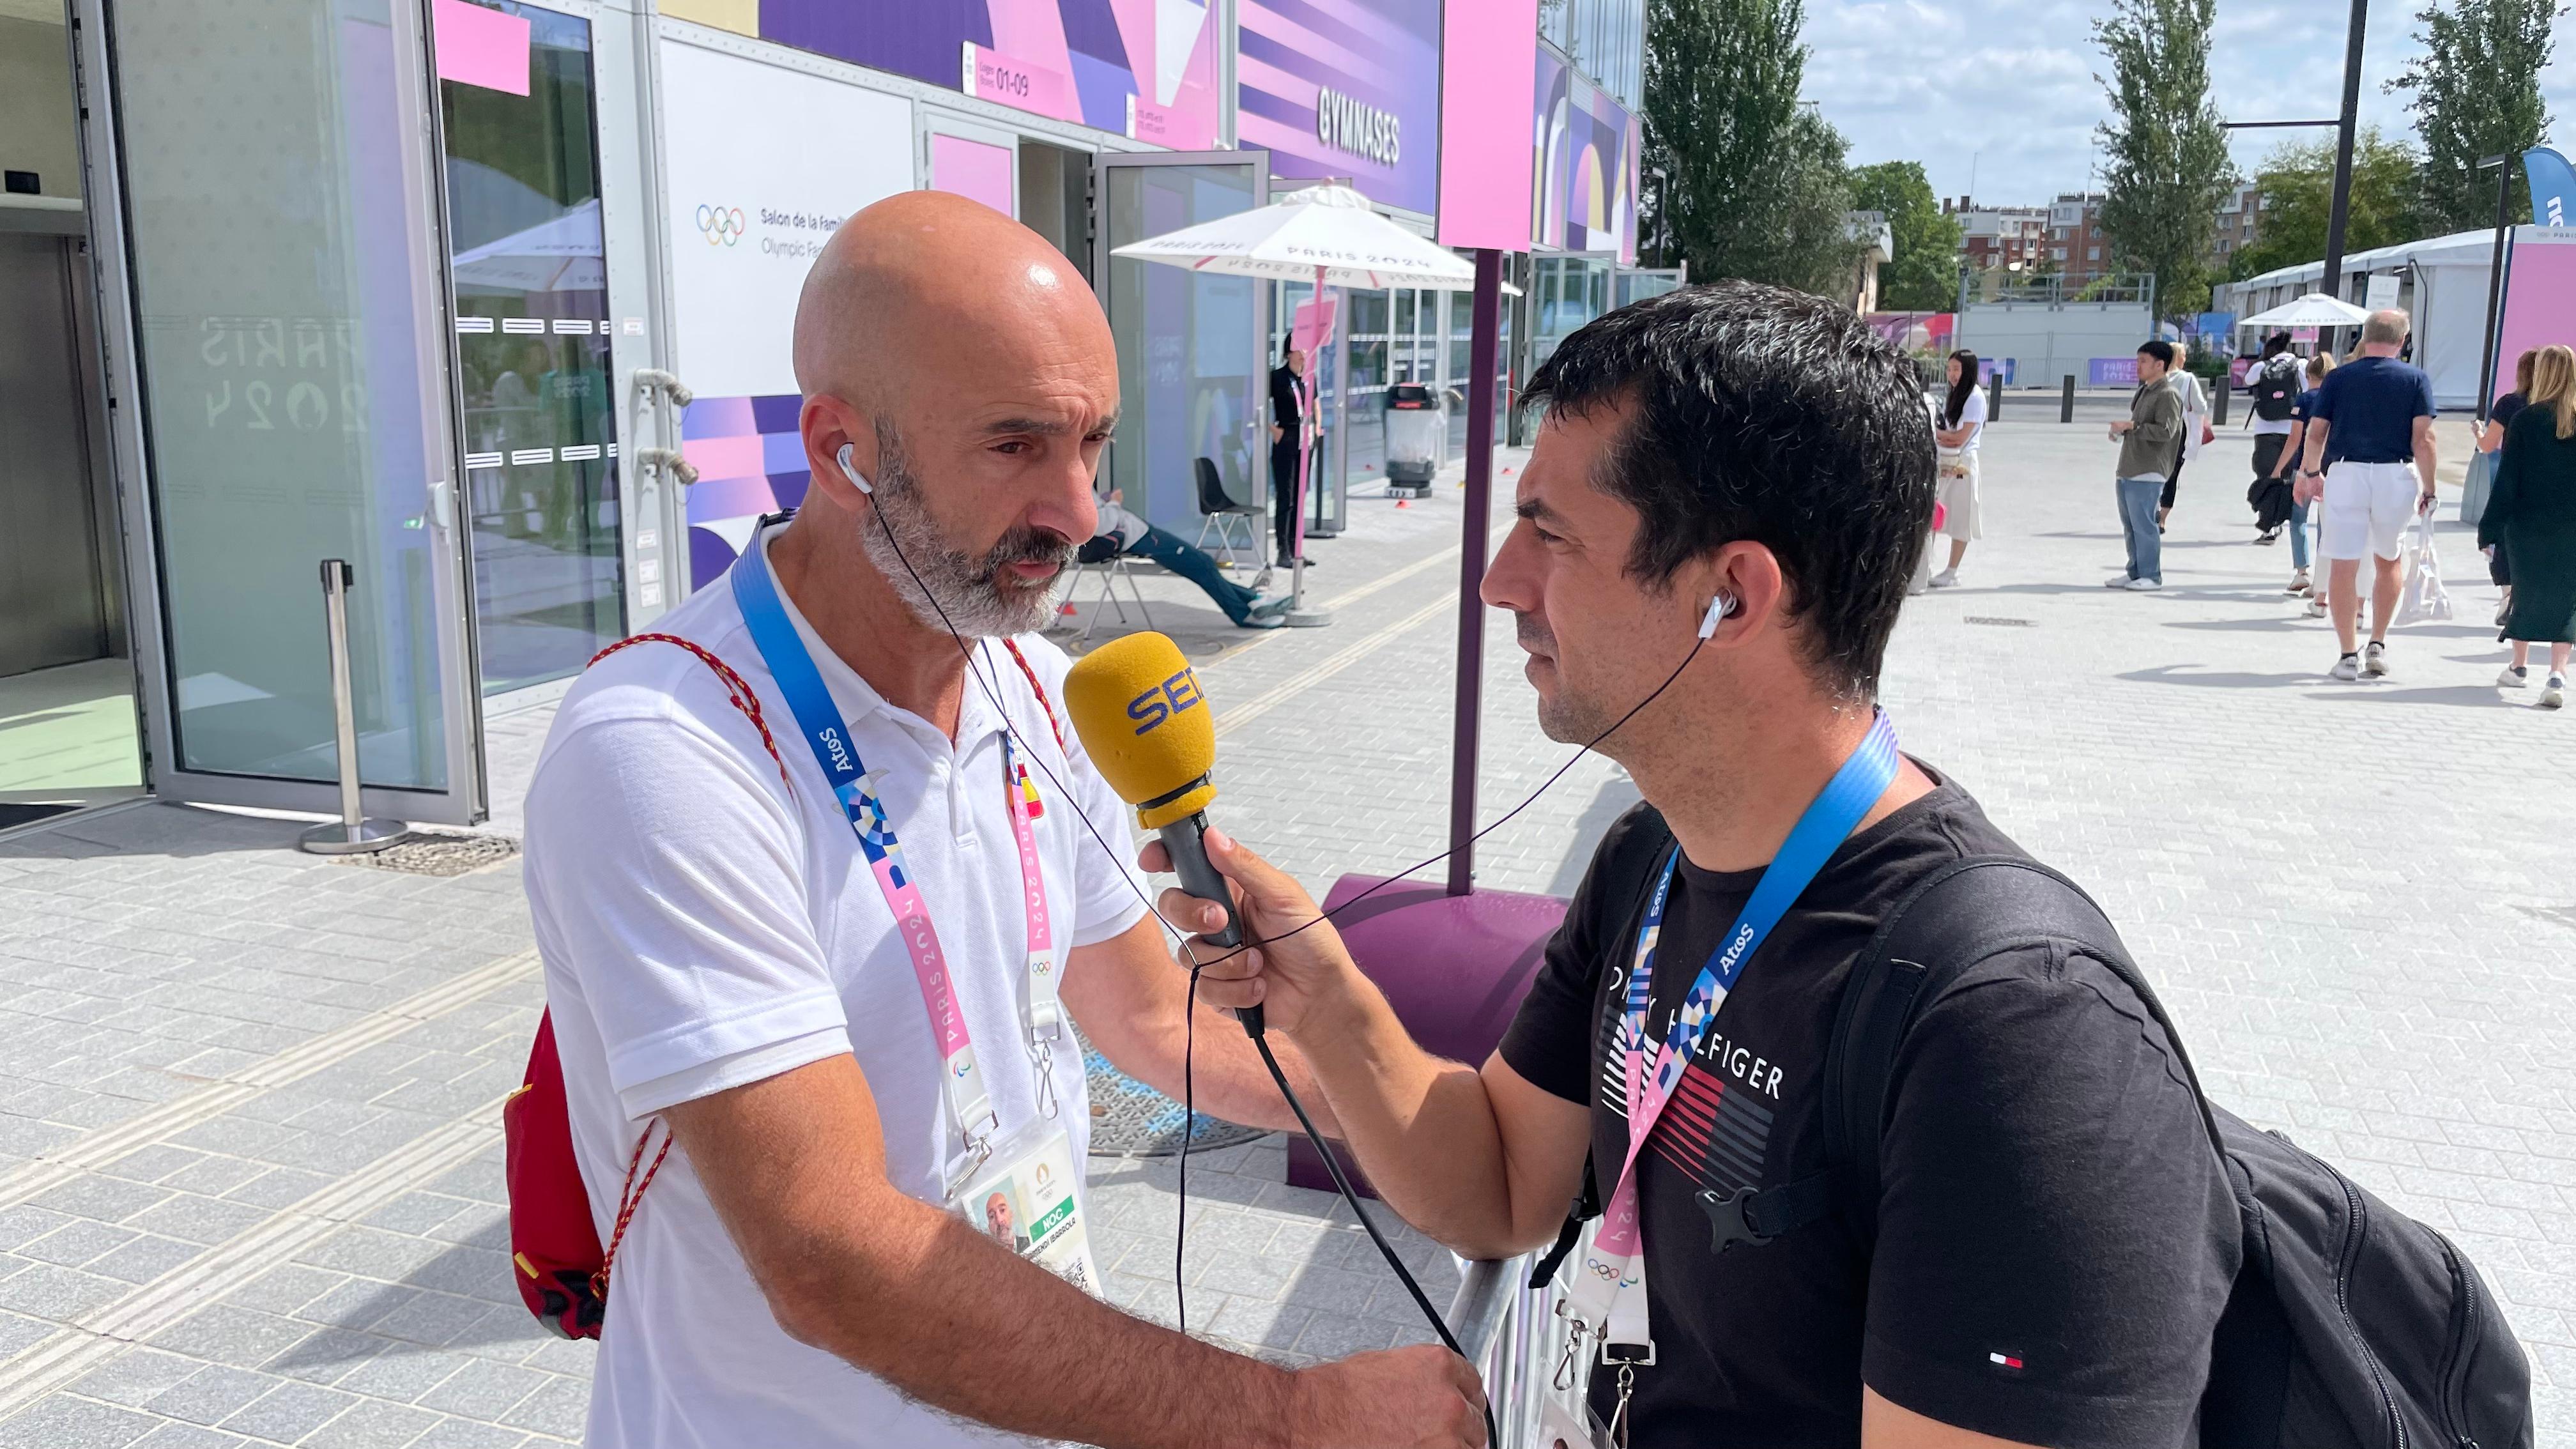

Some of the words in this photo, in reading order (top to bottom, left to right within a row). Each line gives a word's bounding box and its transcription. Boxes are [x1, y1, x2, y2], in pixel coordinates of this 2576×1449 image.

[997, 68, 1028, 97] 01-09
[1319, 85, 1400, 164] GYMNASES
[761, 208, 790, 227] Salon
[792, 212, 806, 228] de
[808, 214, 817, 229] la
[762, 237, 806, 258] Olympic
[1287, 246, 1357, 261] PARIS
[1366, 254, 1431, 268] 2024
[1016, 799, 1034, 867] PARIS
[1028, 877, 1044, 939] 2024
[904, 898, 935, 966] 2024
[930, 970, 958, 1043] PARIS
[1042, 1208, 1064, 1232] NOC
